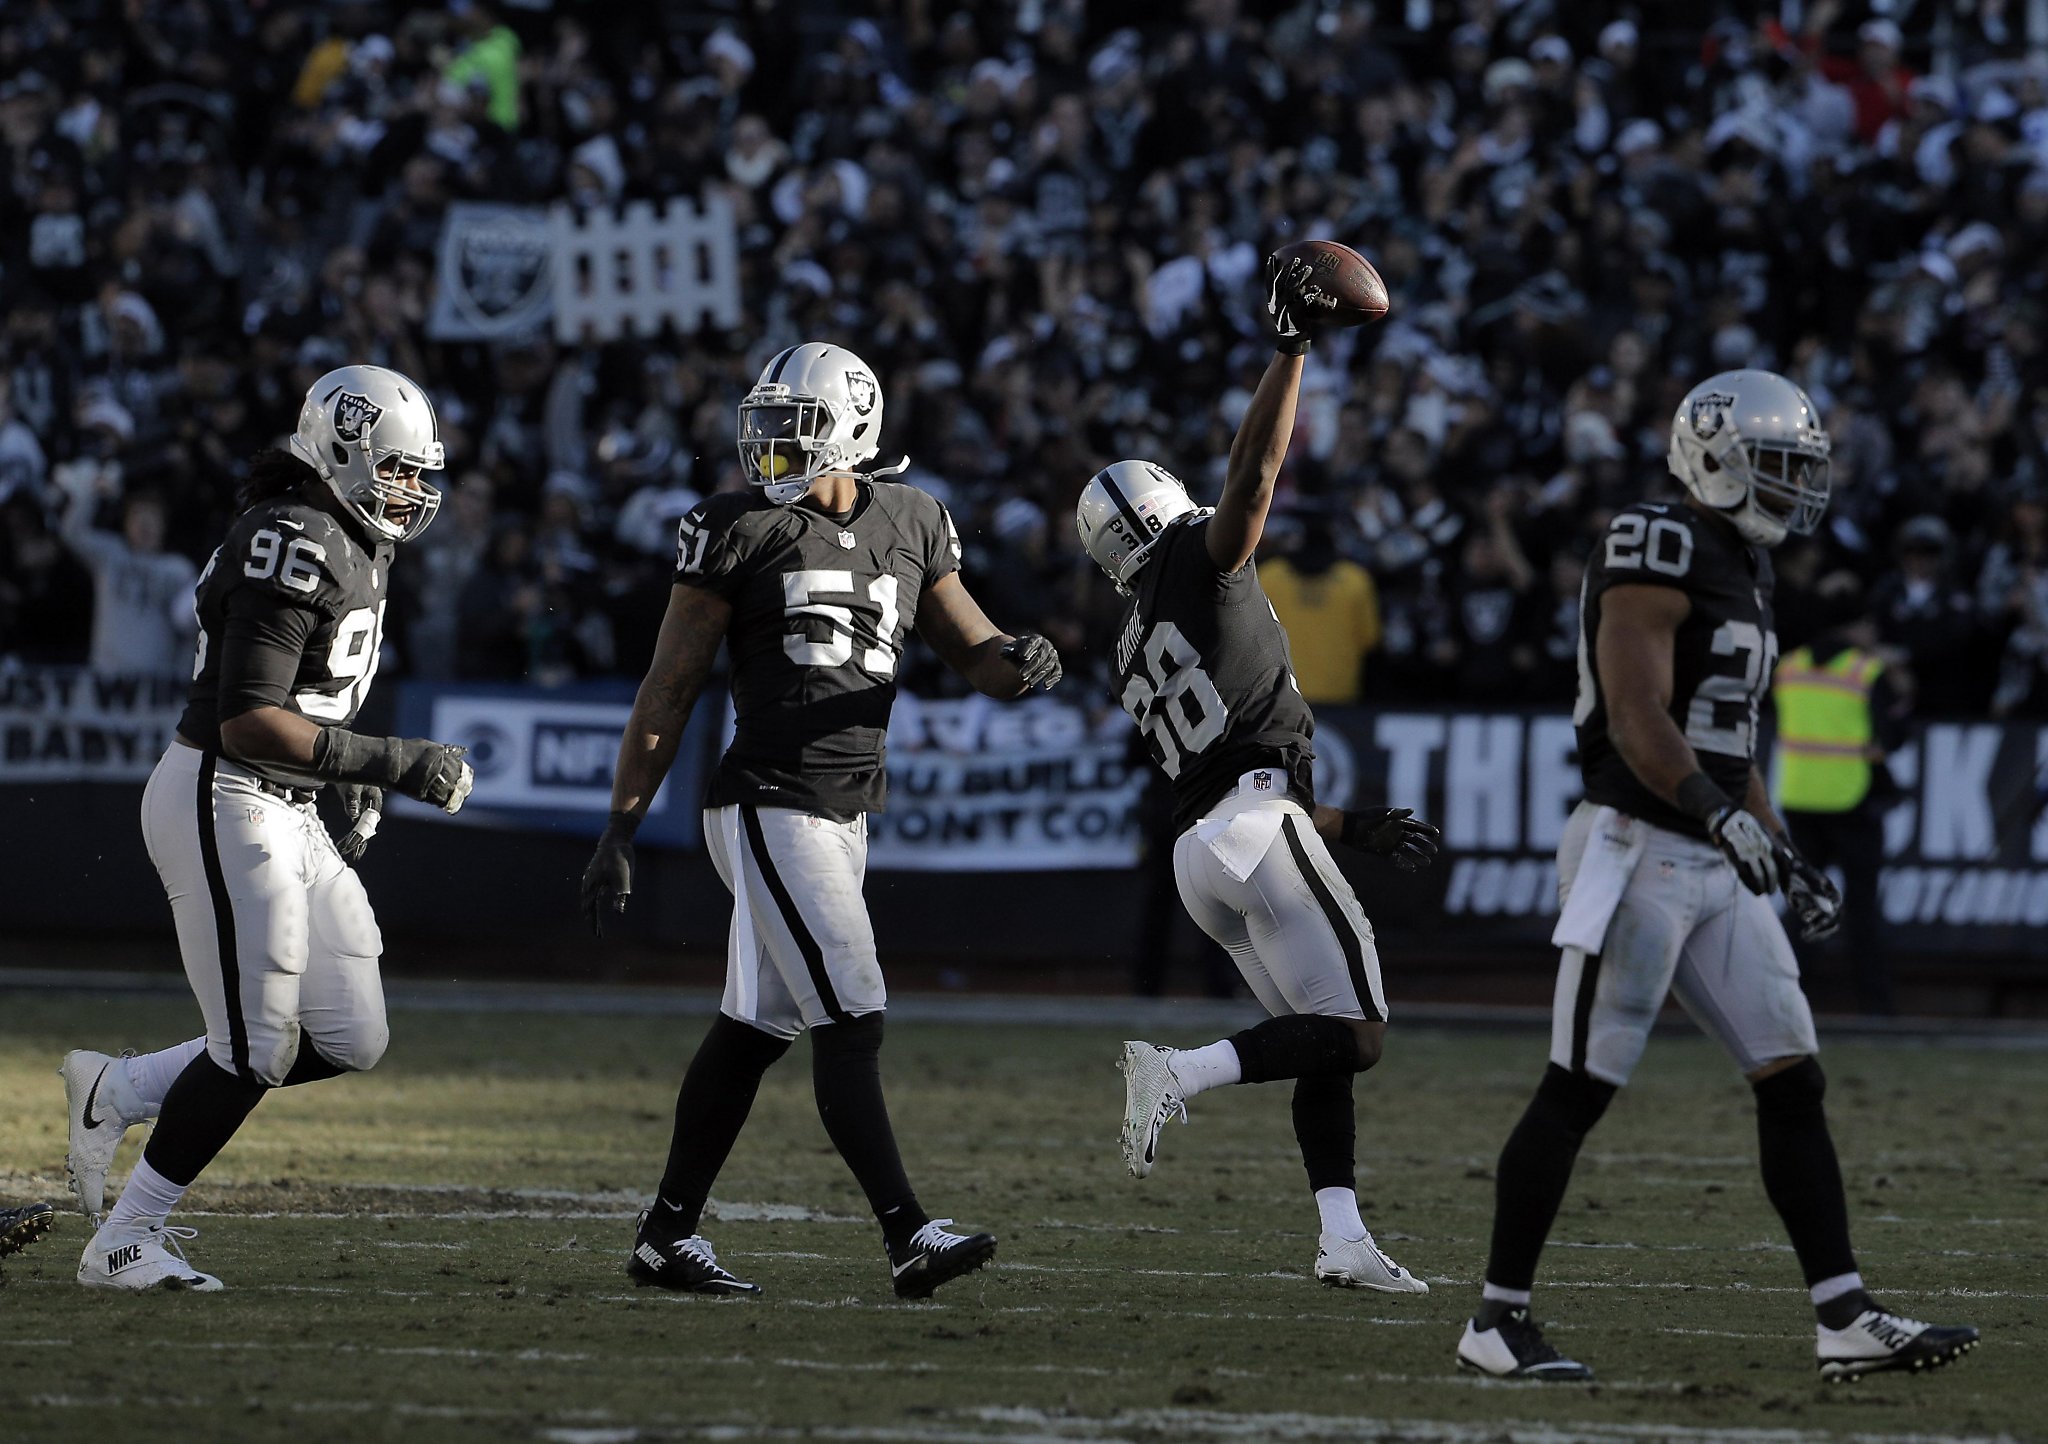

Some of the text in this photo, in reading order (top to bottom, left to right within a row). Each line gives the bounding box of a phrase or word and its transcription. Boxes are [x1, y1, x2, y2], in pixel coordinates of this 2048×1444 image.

[244, 529, 326, 593] 96
[676, 517, 710, 574] 51
[1121, 514, 1163, 551] 3 8
[1604, 513, 1694, 577] 20
[783, 570, 899, 674] 51
[1374, 712, 1585, 851] THE
[108, 1245, 142, 1274] NIKE
[635, 1242, 667, 1272] NIKE
